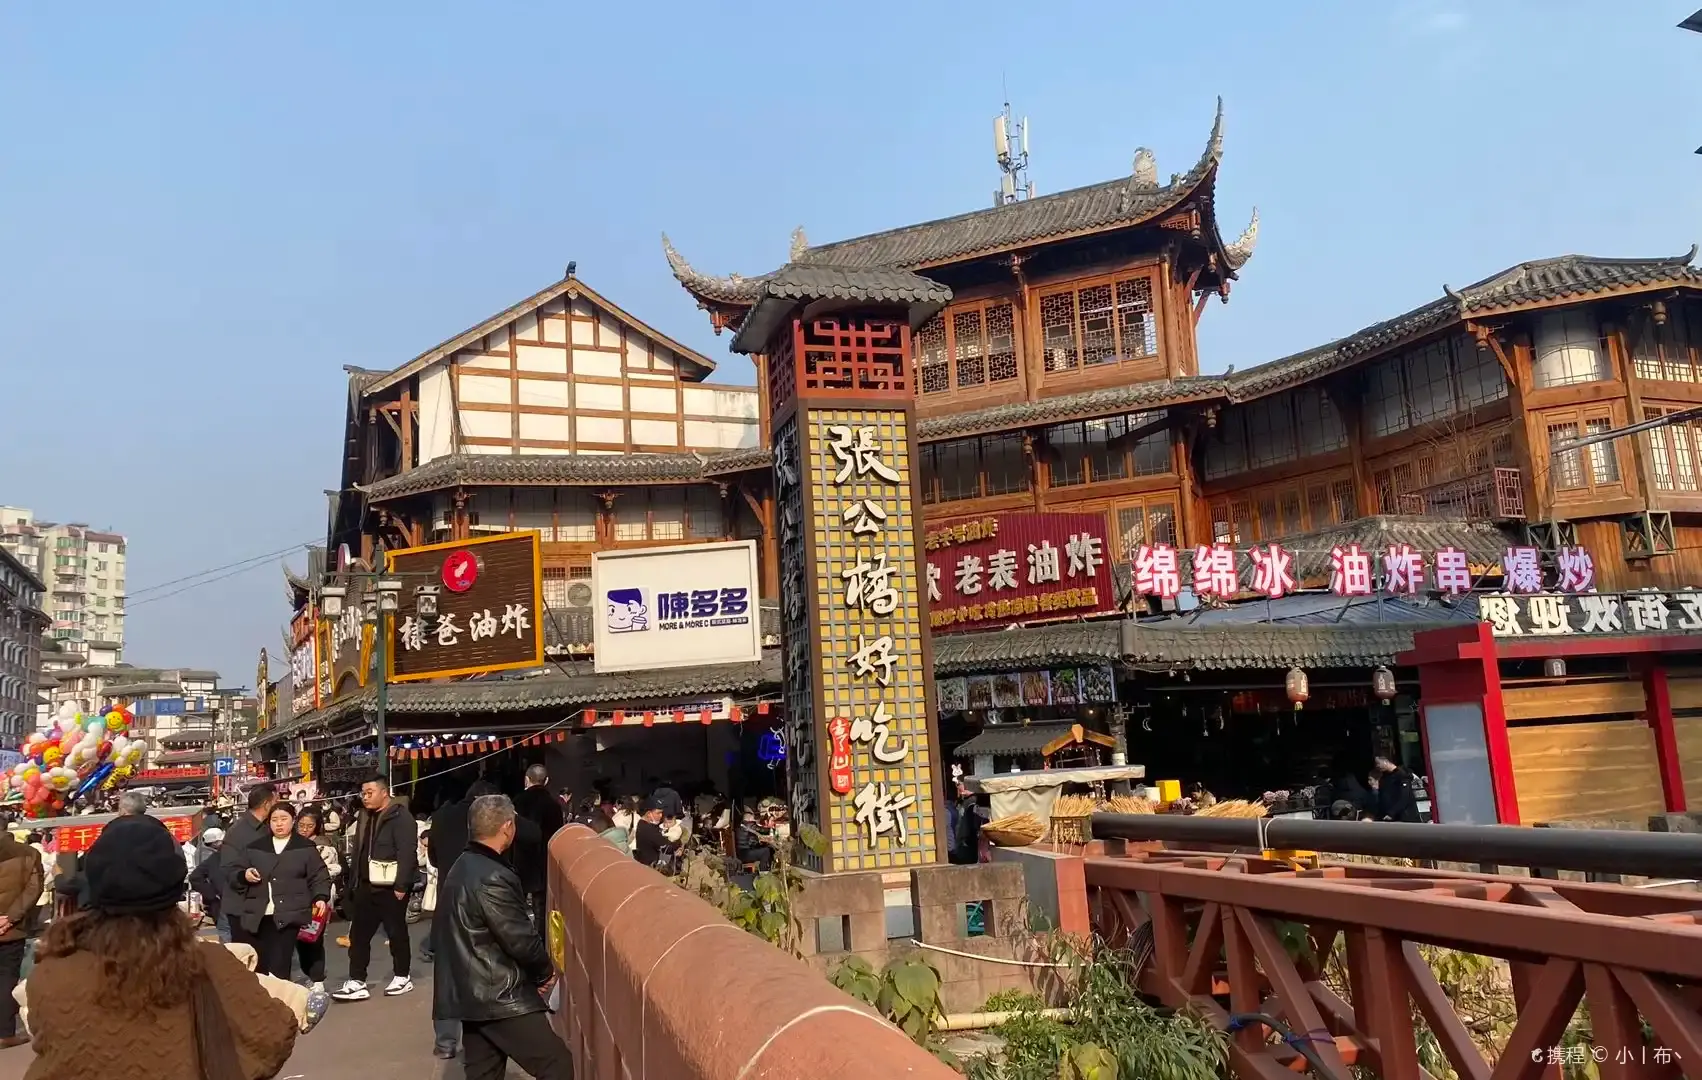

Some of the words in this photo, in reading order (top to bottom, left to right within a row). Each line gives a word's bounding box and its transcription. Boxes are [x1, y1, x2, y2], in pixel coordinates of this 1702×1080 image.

[659, 622, 678, 631] MORE
[685, 619, 704, 629] MORE
[217, 760, 226, 772] P
